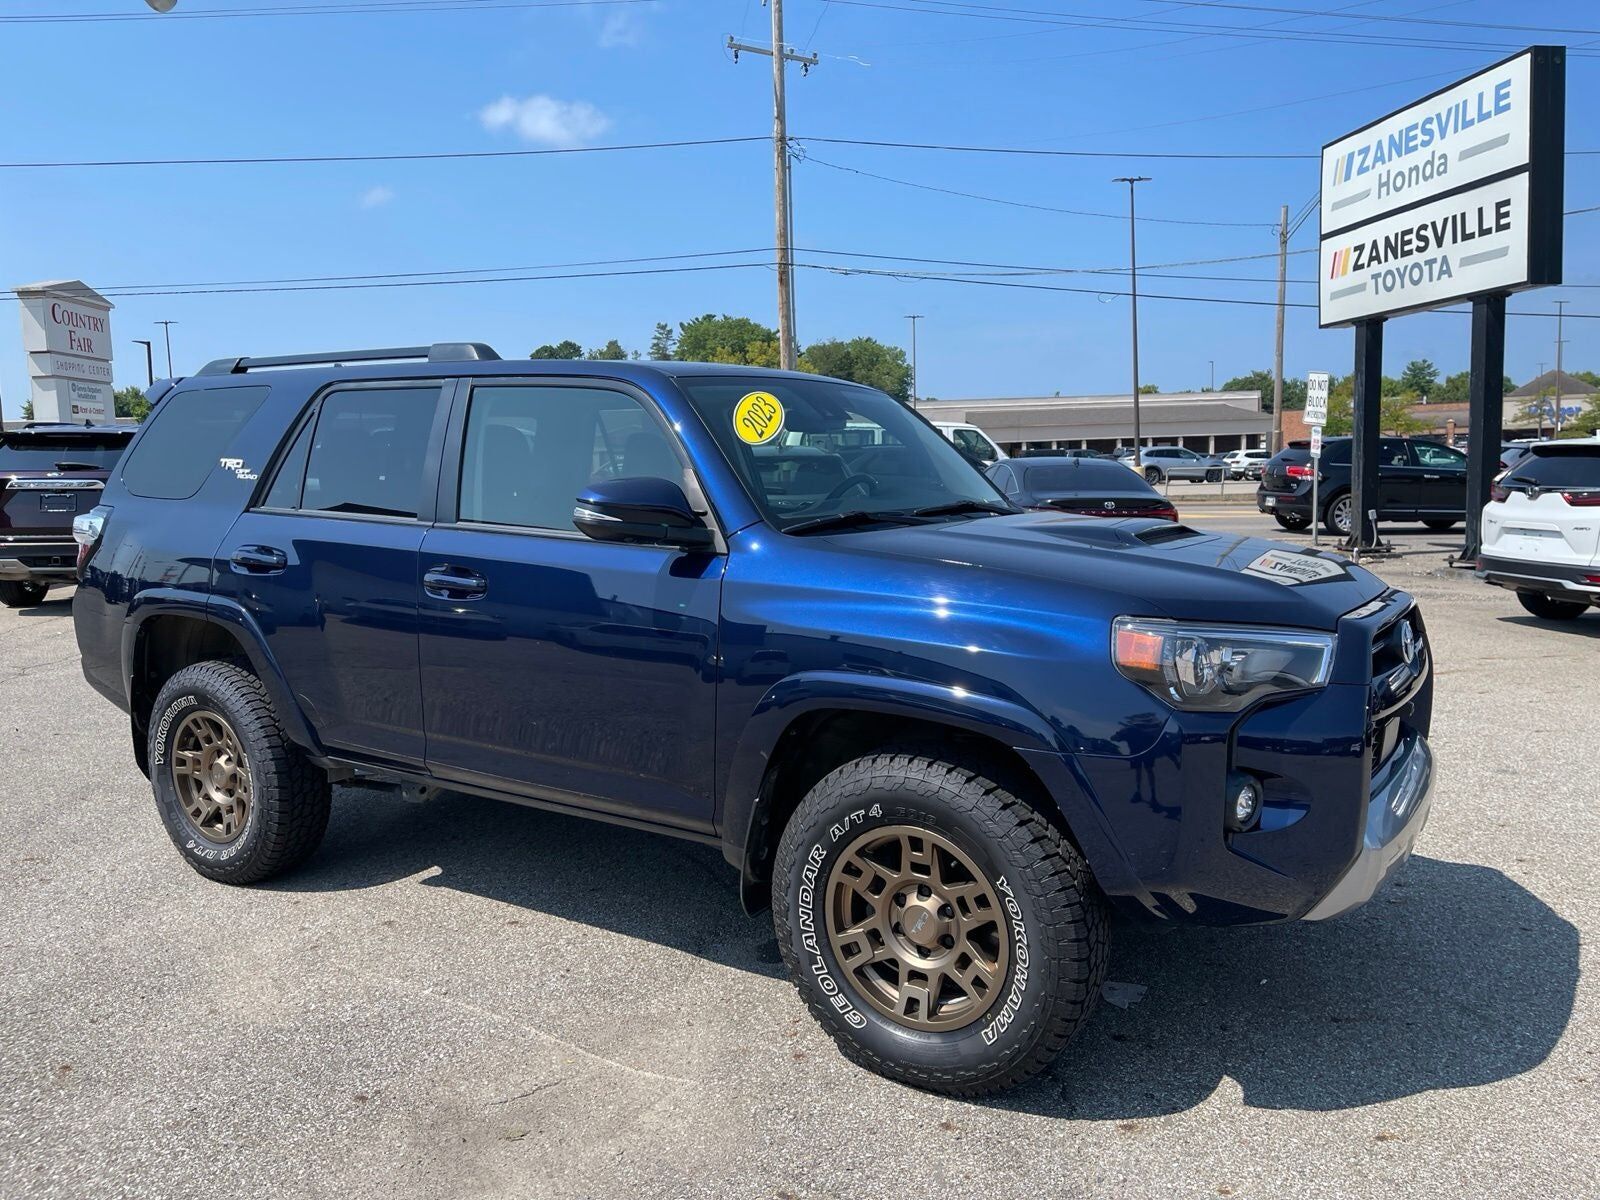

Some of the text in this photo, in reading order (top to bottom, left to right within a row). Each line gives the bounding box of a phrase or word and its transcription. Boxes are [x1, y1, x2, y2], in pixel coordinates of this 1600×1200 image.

[1356, 78, 1512, 177] ZANESVILLE
[1376, 149, 1448, 200] Honda
[1352, 197, 1512, 273] ZANESVILLE
[1370, 254, 1453, 295] TOYOTA
[51, 302, 105, 333] COUNTRY
[68, 330, 94, 353] FAIR
[56, 360, 110, 377] SHOPPING CENTER
[1309, 379, 1328, 392] DO NOT
[743, 396, 776, 438] 2023
[1307, 395, 1327, 409] BLOCK
[220, 457, 244, 470] TRD
[155, 695, 198, 765] YOKOHAMA
[799, 843, 868, 1030] GEOLANDAR
[981, 875, 1031, 1045] YOKOHAMA
